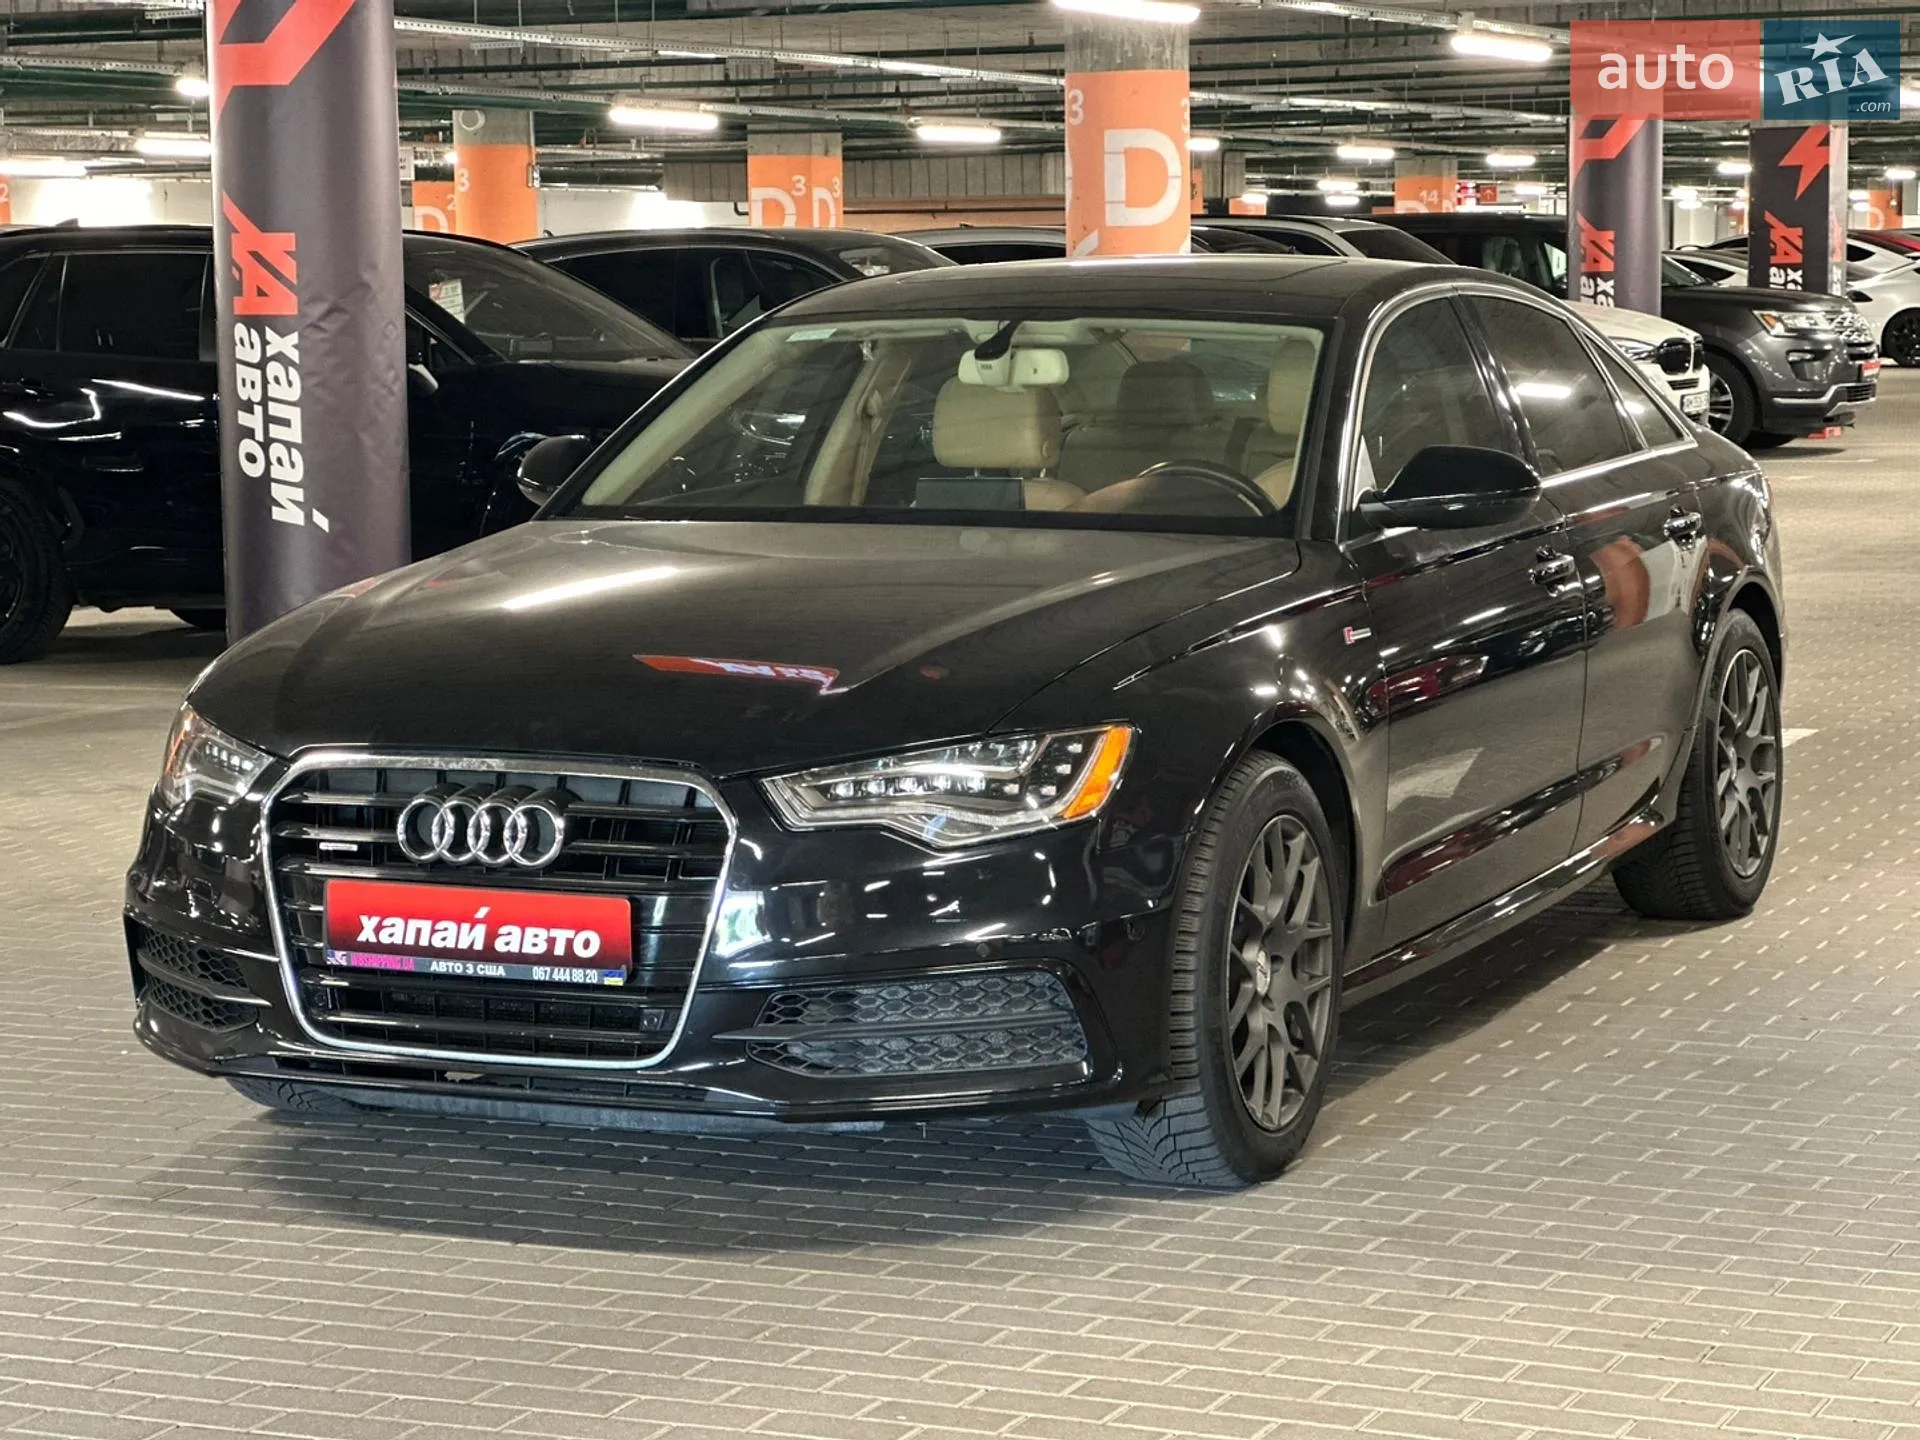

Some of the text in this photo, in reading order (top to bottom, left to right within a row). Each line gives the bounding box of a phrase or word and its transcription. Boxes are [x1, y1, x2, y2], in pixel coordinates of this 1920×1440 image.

[1068, 89, 1084, 125] 3
[458, 168, 470, 192] 3
[791, 174, 807, 197] 3
[1104, 128, 1182, 227] D
[1419, 189, 1438, 205] 14
[234, 322, 266, 478] авто
[265, 326, 329, 533] хапай
[356, 906, 601, 958] хапай авто
[430, 961, 463, 974] АВТО
[476, 964, 506, 976] США
[532, 966, 550, 980] 067
[552, 968, 570, 982] 444
[586, 969, 598, 984] 20
